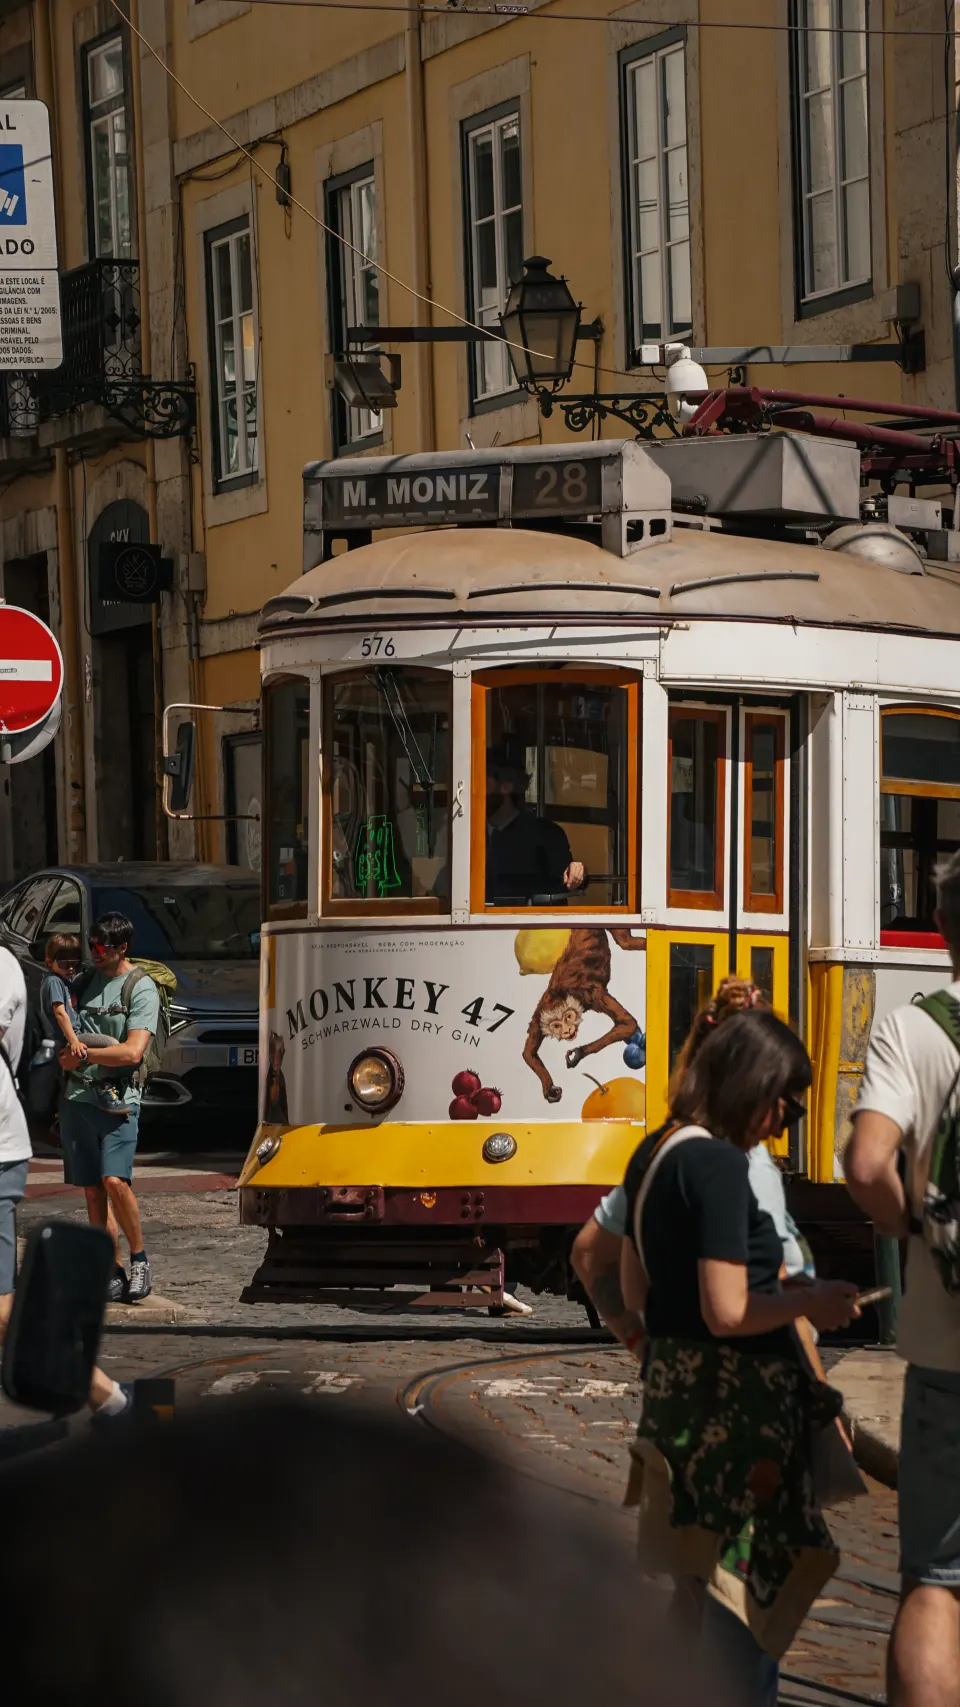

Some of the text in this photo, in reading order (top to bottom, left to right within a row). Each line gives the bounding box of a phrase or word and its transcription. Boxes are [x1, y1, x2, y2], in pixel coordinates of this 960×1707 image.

[41, 276, 45, 285] É
[27, 287, 41, 295] COM
[5, 307, 12, 315] DA
[14, 307, 22, 315] LEI
[21, 316, 25, 325] E
[26, 316, 42, 325] BENS
[1, 327, 31, 335] CRIMINAL.
[24, 336, 39, 344] PELO
[12, 346, 34, 354] DADOS:
[19, 355, 44, 364] PÚBLICA
[534, 462, 589, 505] 28
[343, 473, 489, 507] M. MONIZ
[361, 636, 396, 657] 576
[418, 939, 465, 948] MODERAÇÃO
[285, 977, 516, 1041] MONKEY 47
[301, 1017, 481, 1050] SCHWARZWALD DRY GIN
